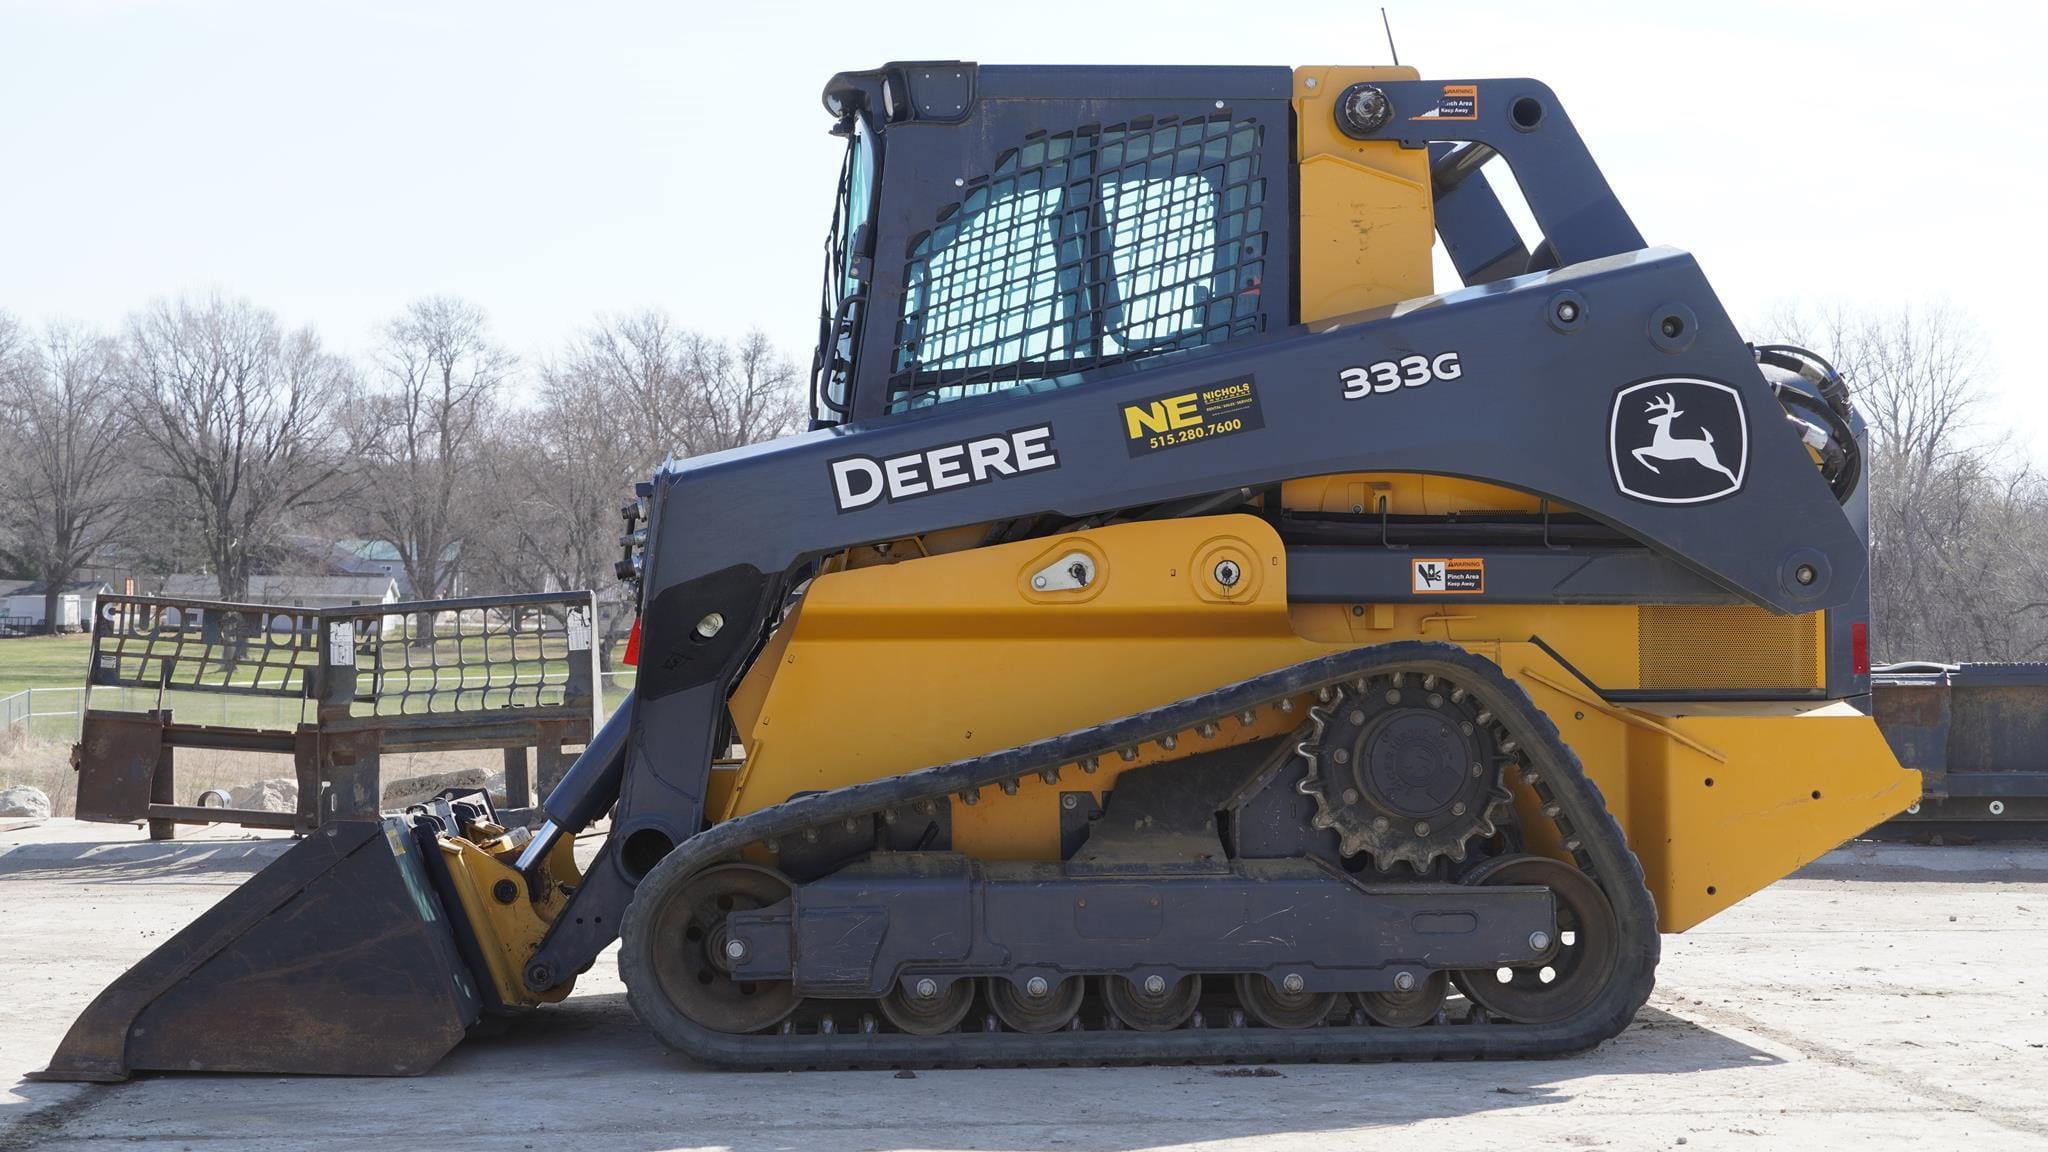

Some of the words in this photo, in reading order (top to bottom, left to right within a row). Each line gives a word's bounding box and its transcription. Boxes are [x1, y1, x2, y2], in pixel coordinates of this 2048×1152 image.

[1203, 383, 1250, 400] NICHOLS
[1340, 352, 1462, 399] 333G
[1124, 392, 1203, 439] NE
[1150, 418, 1242, 449] 515.280.7600
[831, 427, 1056, 509] DEERE
